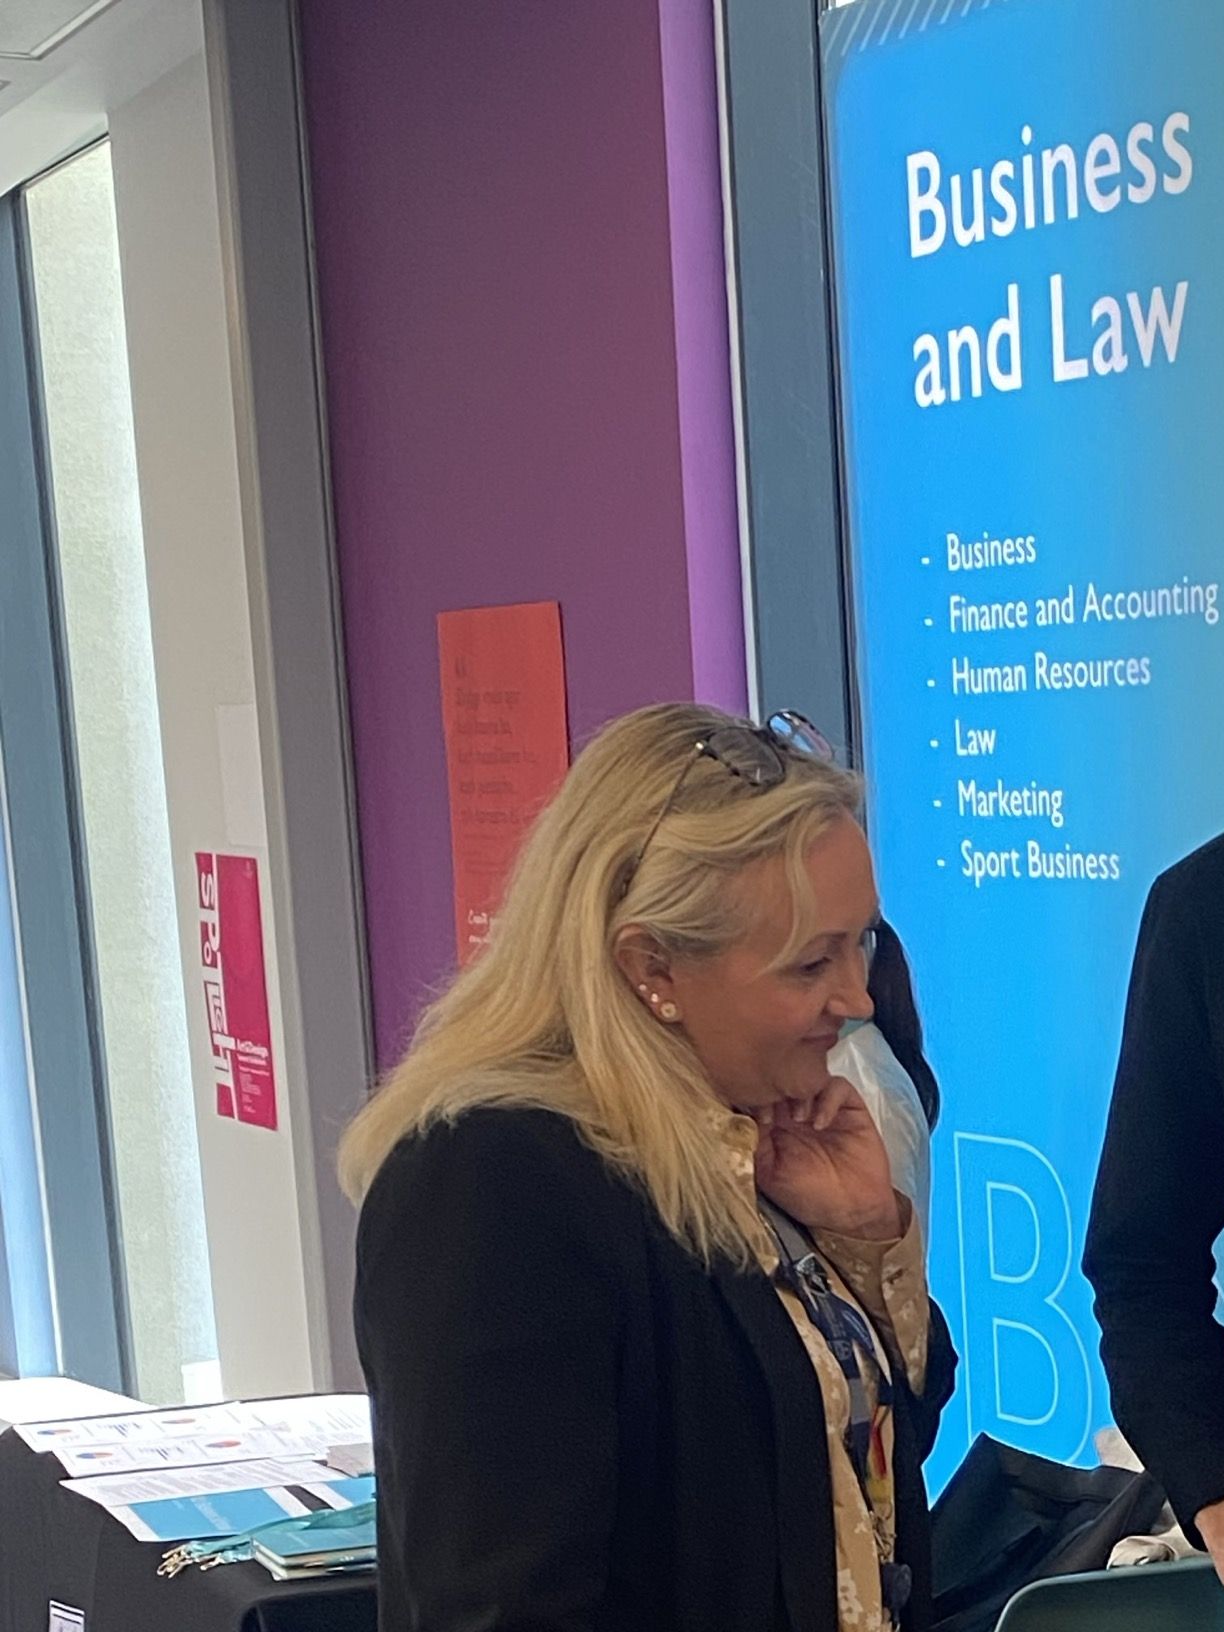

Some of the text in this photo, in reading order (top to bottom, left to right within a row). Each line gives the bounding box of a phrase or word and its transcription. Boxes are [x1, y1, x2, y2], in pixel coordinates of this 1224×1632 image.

[907, 111, 1194, 258] Business
[912, 273, 1189, 408] and Law
[946, 532, 1037, 571] Business
[950, 576, 1220, 633] Finance and Accounting
[952, 651, 1151, 695] Human Resources
[955, 719, 996, 756] Law
[957, 779, 1064, 828] Marketing
[961, 840, 1120, 888] Sport Business
